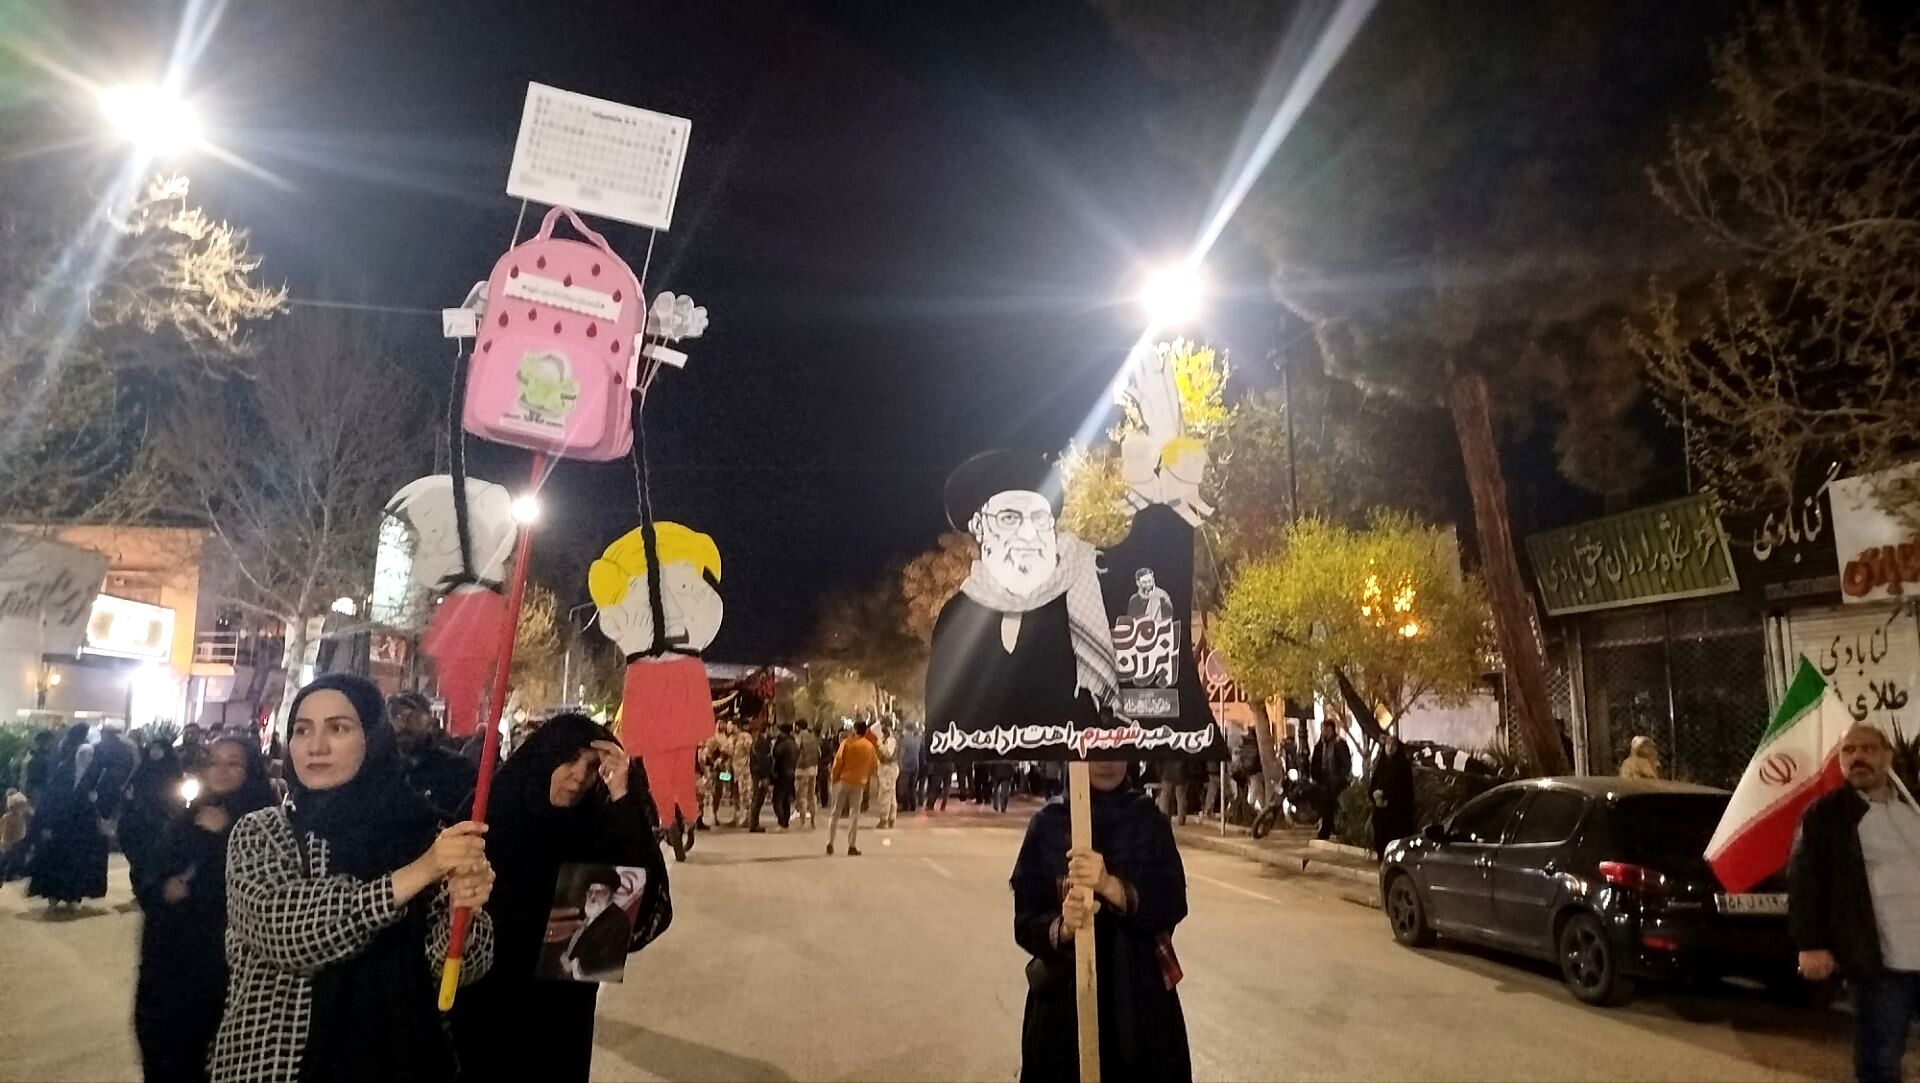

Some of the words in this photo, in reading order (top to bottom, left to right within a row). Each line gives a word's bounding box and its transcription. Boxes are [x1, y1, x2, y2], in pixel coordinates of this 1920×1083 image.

[1115, 651, 1180, 689] ایران
[929, 720, 969, 755] دارد
[970, 724, 1019, 756] ادامه
[1018, 720, 1080, 751] راهت
[1079, 719, 1142, 760] شهیدم
[1137, 724, 1183, 751] رهبر
[1182, 722, 1214, 754] ای
